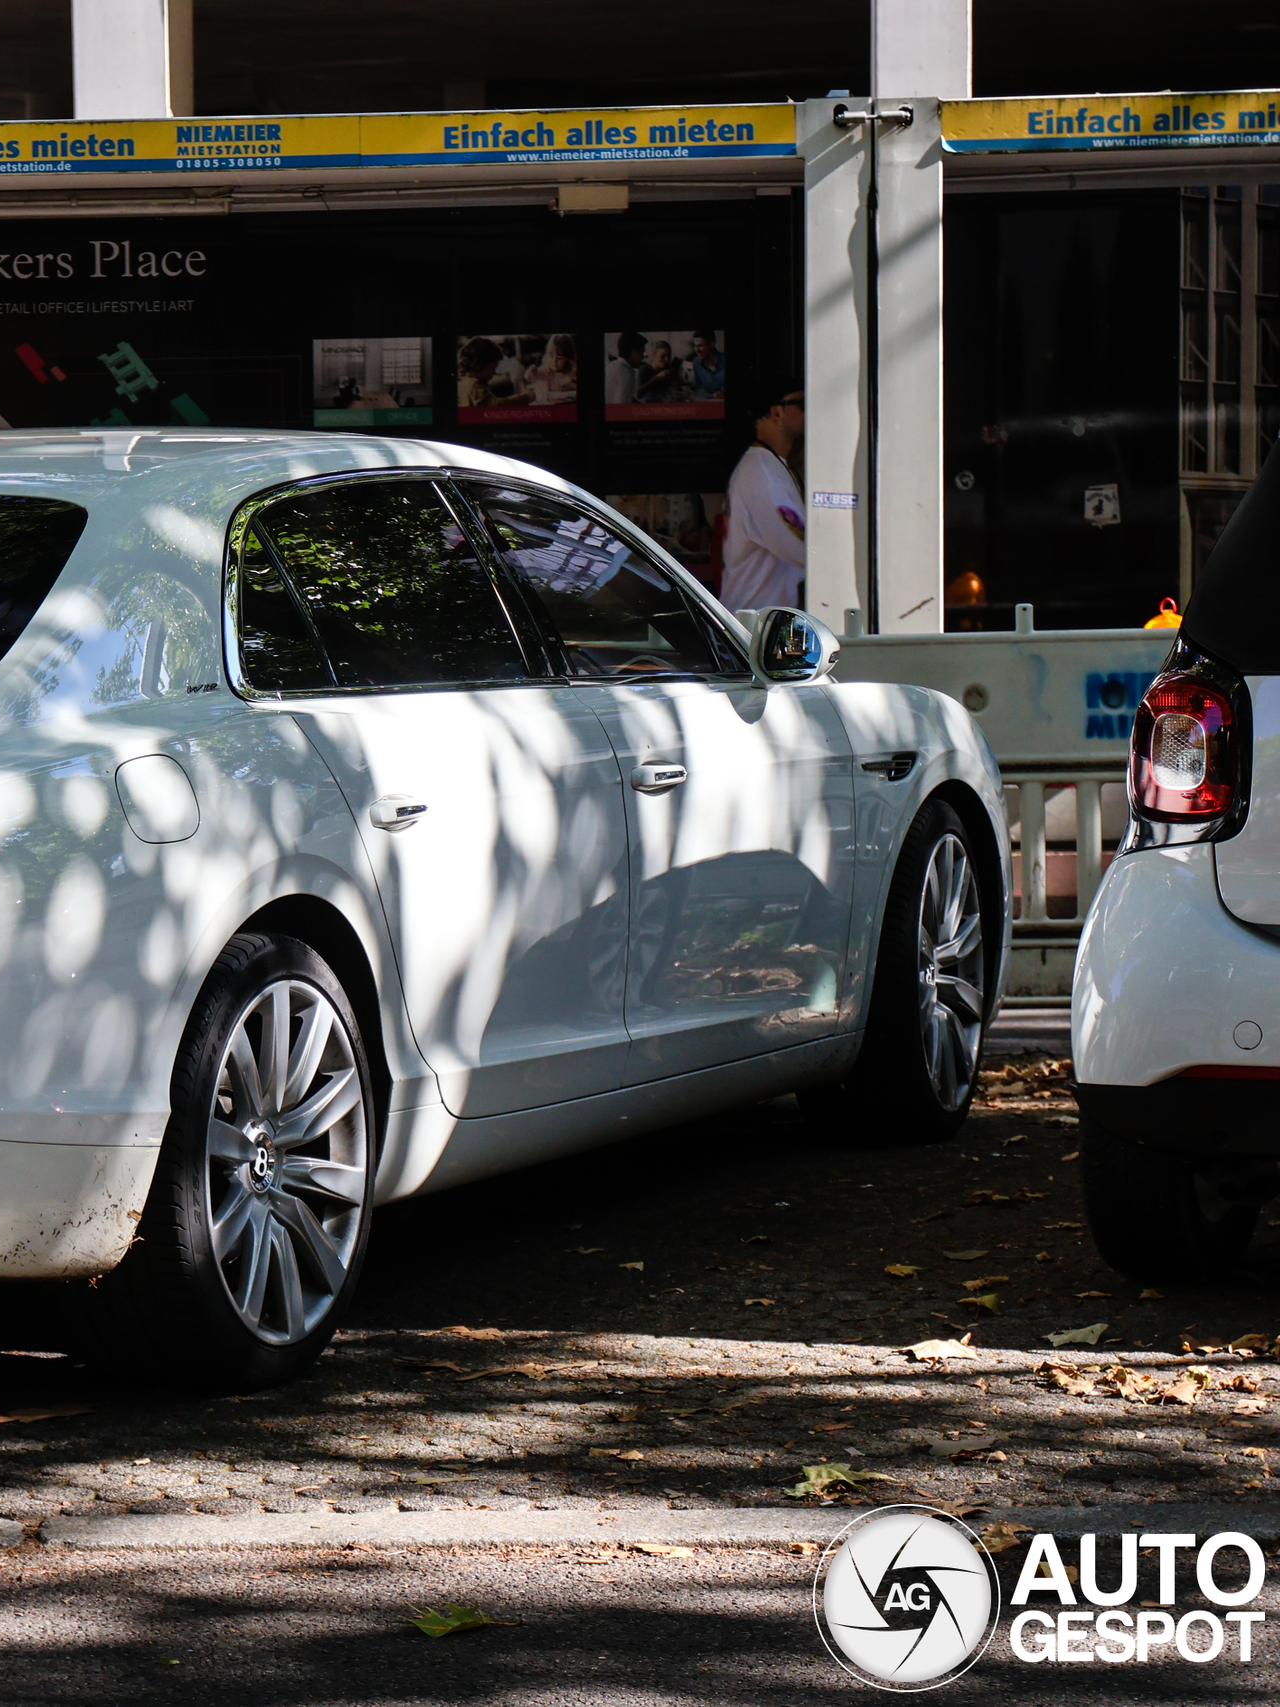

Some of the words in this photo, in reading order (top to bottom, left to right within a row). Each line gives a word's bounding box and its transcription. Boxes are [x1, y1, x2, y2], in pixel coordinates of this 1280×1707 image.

[1028, 107, 1141, 135] Einfach
[1153, 106, 1225, 132] alles
[1238, 104, 1280, 129] mi
[176, 124, 282, 143] NIEMEIER
[443, 122, 555, 149] Einfach
[566, 120, 637, 146] alles
[648, 118, 754, 143] mieten
[31, 132, 135, 158] mieten
[177, 144, 281, 156] MIETSTATION
[506, 147, 689, 162] www.niemeier-mietstation.de
[176, 157, 282, 169] 01805-308050
[89, 240, 207, 278] Place
